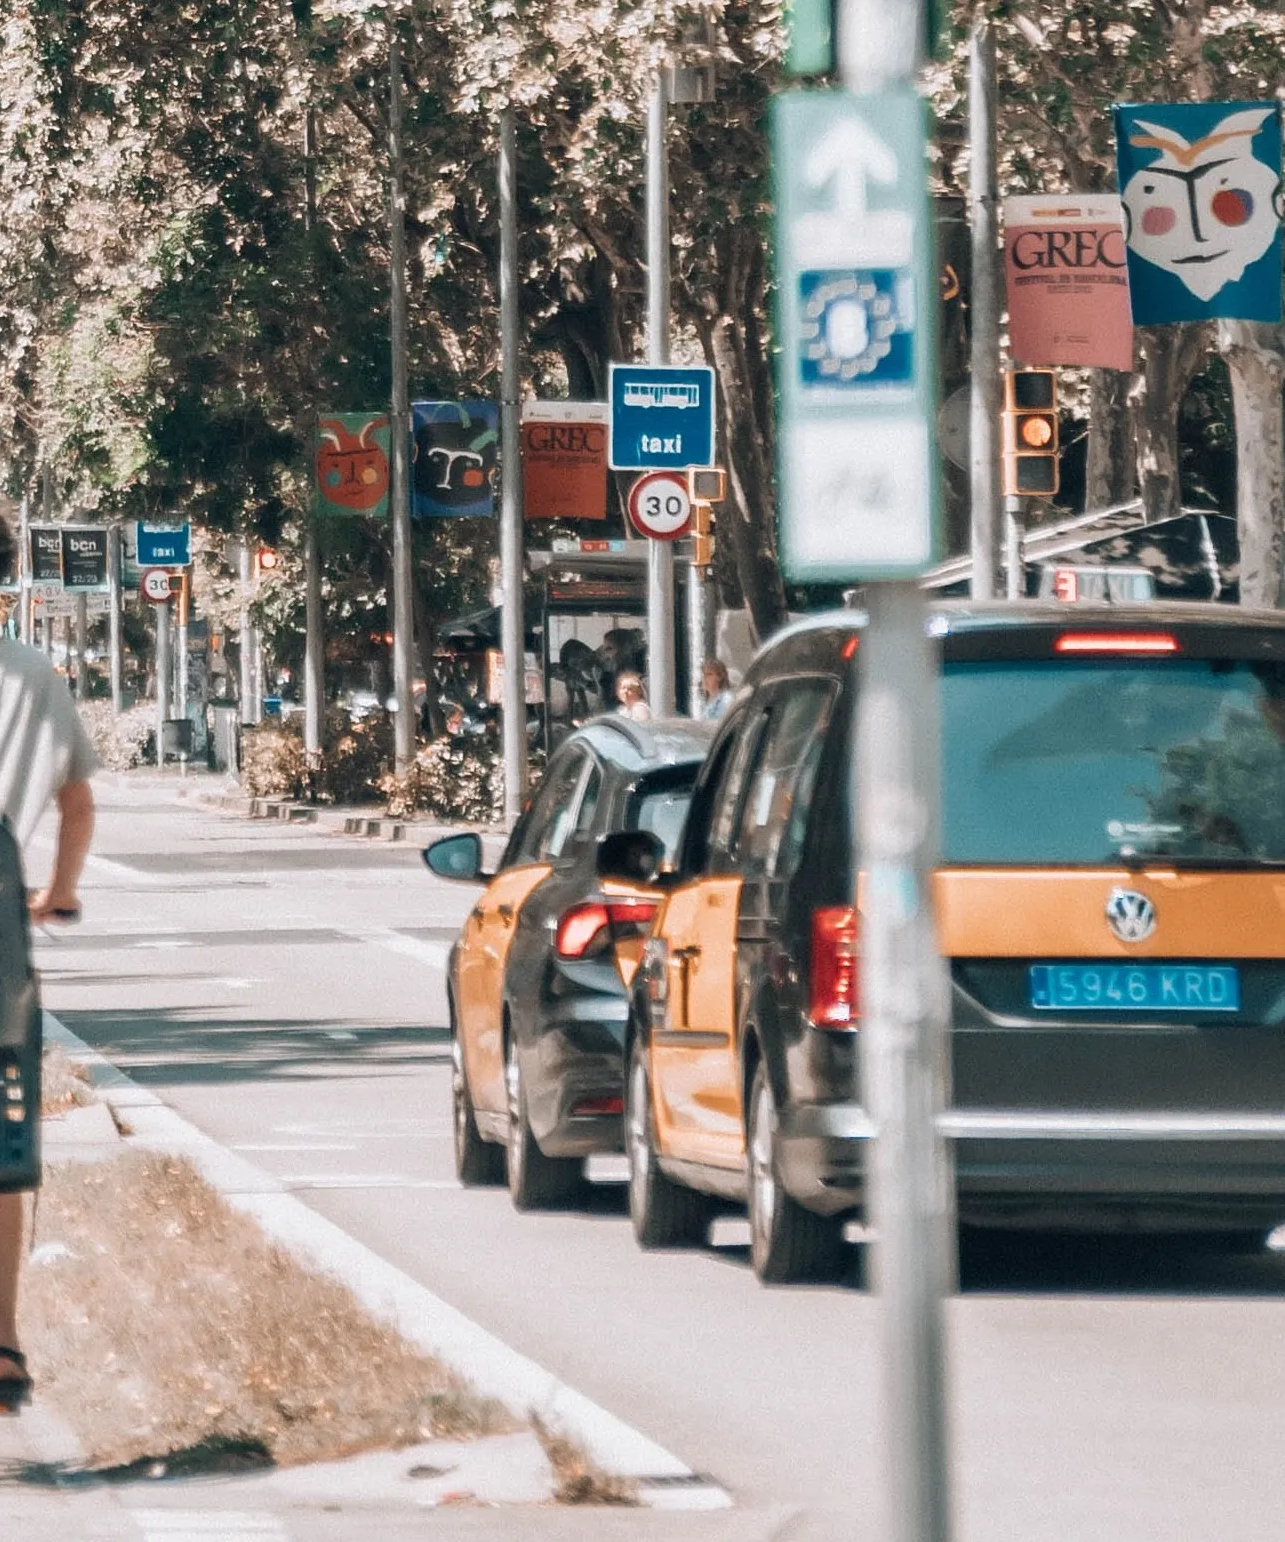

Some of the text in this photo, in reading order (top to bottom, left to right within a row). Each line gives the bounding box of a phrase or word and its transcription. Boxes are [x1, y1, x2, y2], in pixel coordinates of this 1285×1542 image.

[1011, 230, 1127, 270] GREC
[527, 426, 606, 453] GREC
[641, 434, 682, 454] taxi
[645, 496, 682, 518] 30
[70, 539, 97, 551] bcn
[153, 548, 175, 558] taxi
[149, 579, 168, 592] 30
[1059, 970, 1226, 1003] 5946 KRD
